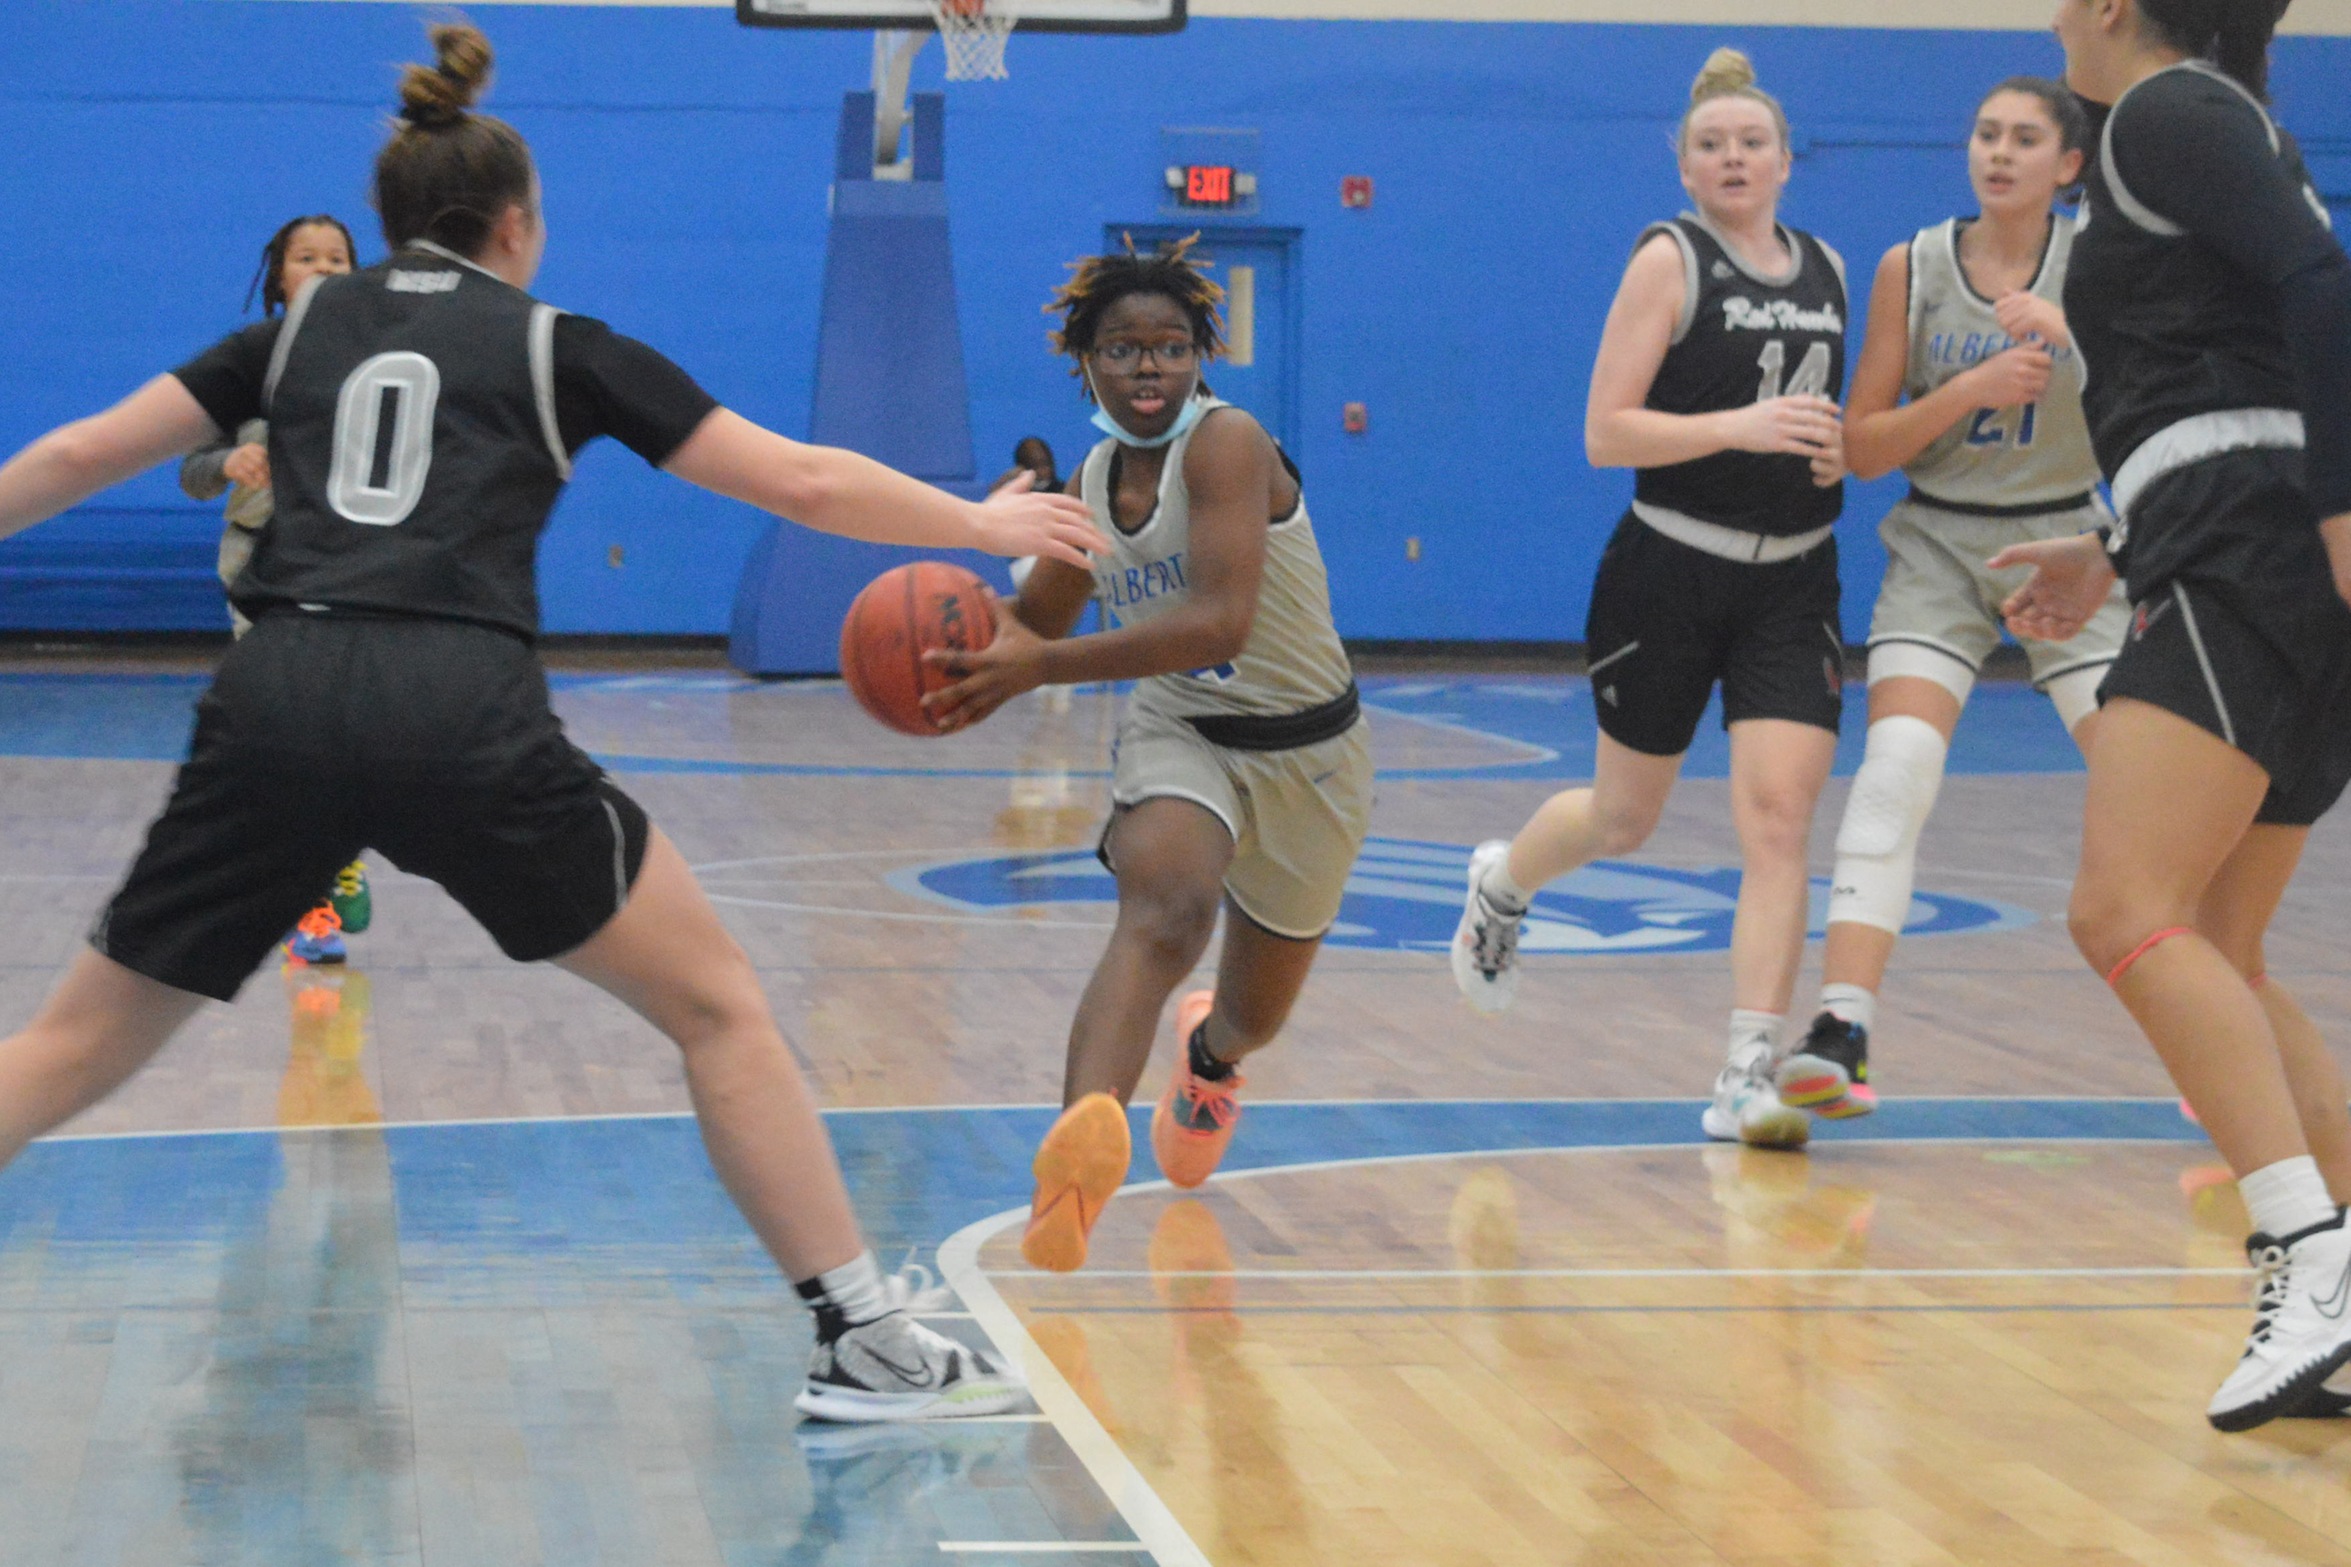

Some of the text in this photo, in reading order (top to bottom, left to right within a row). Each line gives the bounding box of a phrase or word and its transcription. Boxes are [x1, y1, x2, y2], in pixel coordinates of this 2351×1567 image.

[1187, 166, 1231, 202] EXIT
[1756, 338, 1832, 404] 14
[326, 350, 441, 526] 0
